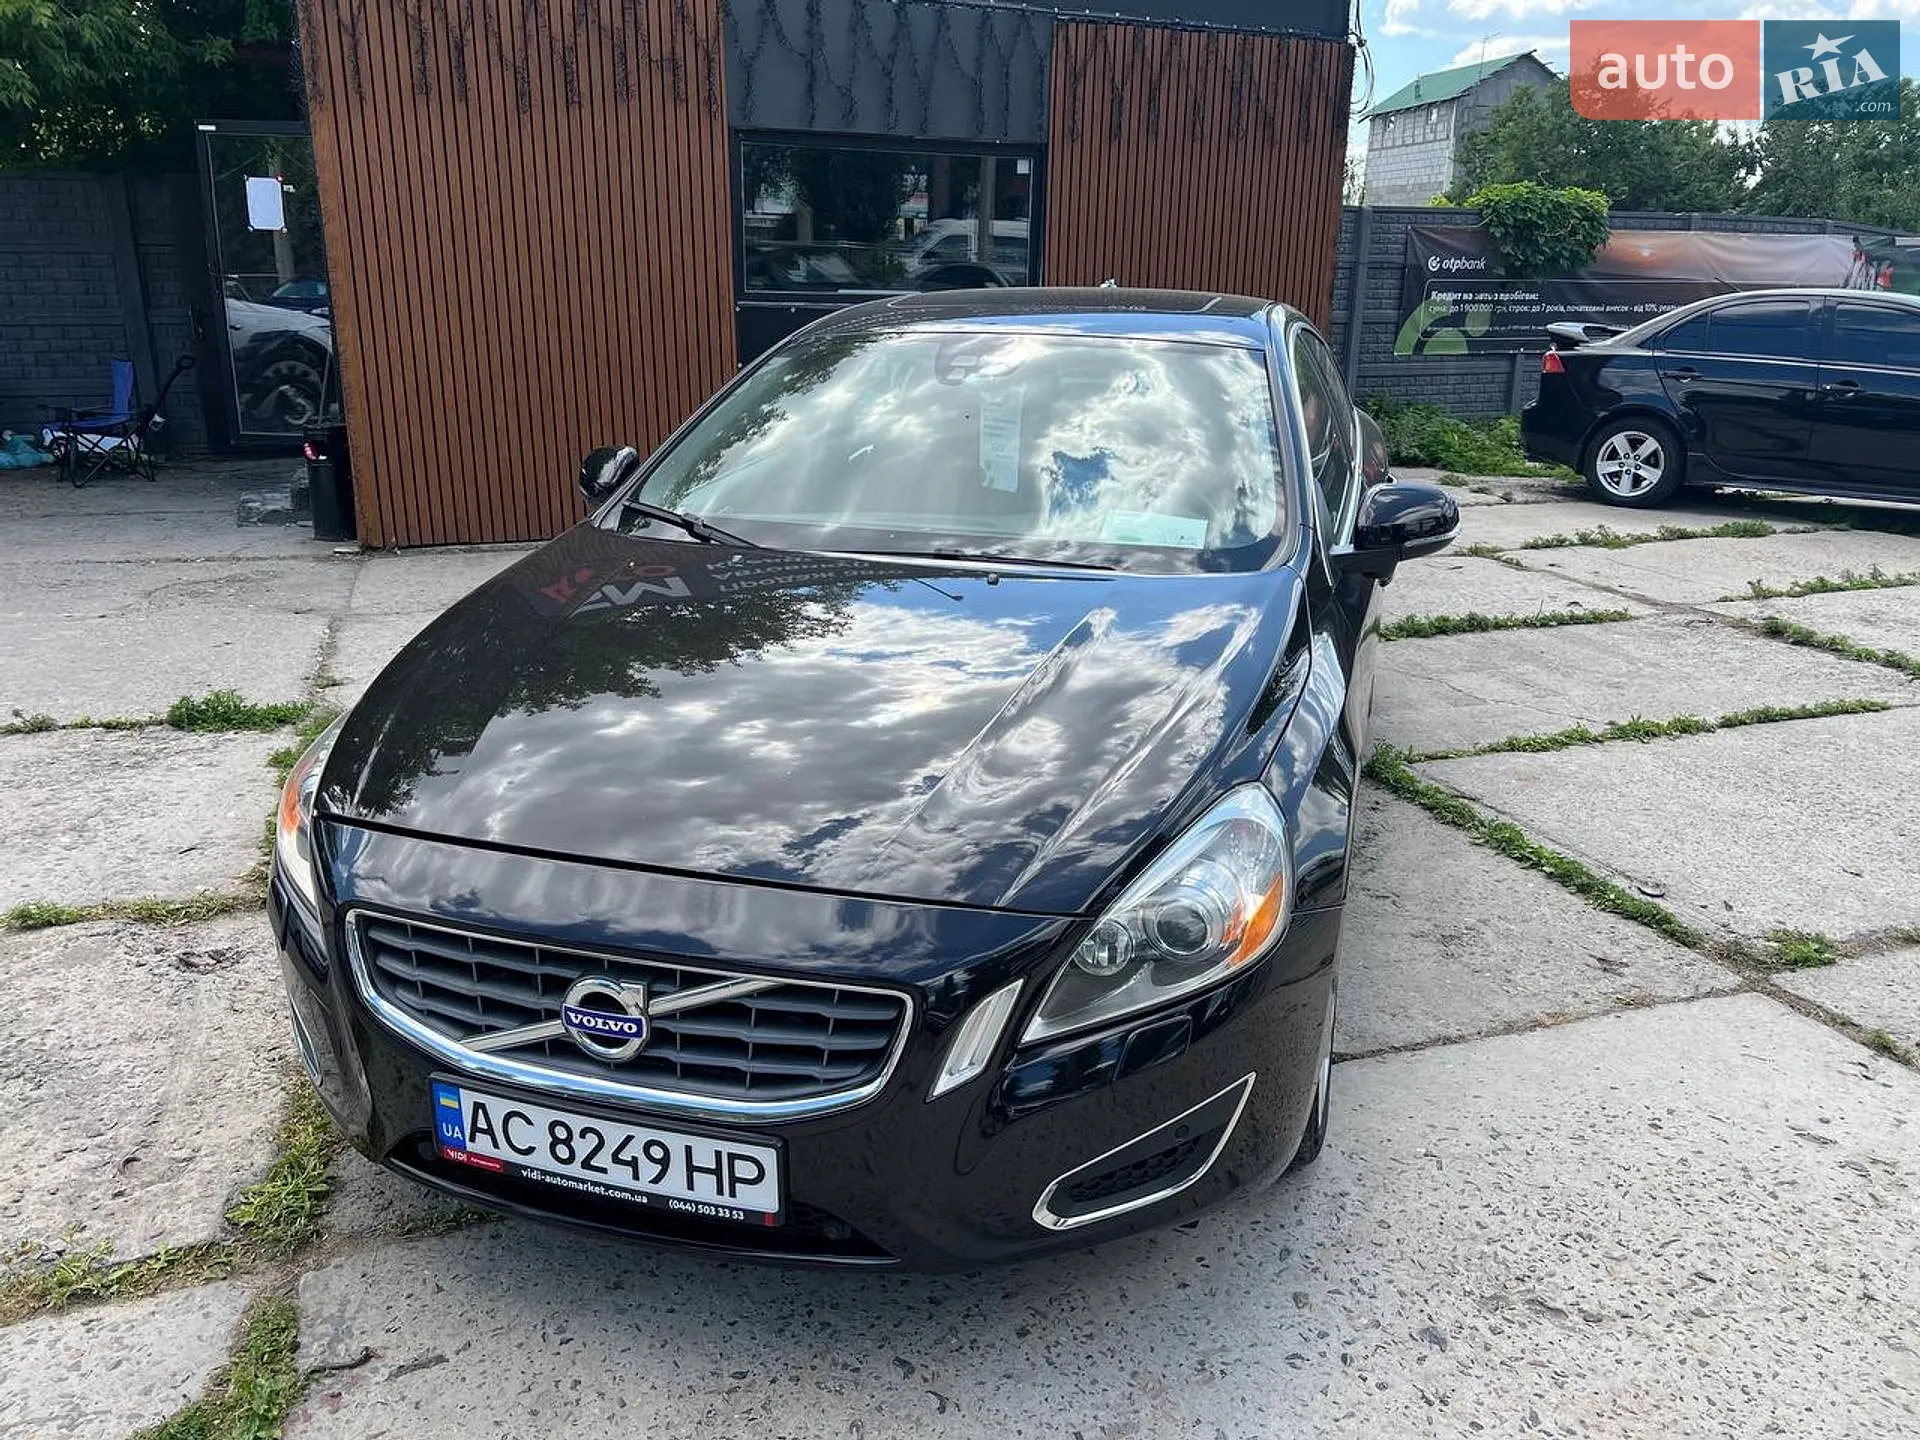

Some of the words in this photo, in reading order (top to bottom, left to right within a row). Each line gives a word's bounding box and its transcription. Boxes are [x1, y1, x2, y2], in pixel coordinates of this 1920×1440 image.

[1441, 256, 1487, 273] otpbank
[1431, 290, 1462, 302] Кредит
[1463, 292, 1473, 300] на
[1449, 304, 1459, 313] до
[566, 1010, 638, 1034] VOLVO
[443, 1121, 464, 1140] UA
[468, 1101, 536, 1156] AC
[547, 1119, 672, 1185] 8249
[684, 1144, 766, 1199] HP
[521, 1167, 649, 1204] vidi-automarket.com.ua
[668, 1199, 696, 1214] (044)
[697, 1204, 717, 1217] 503
[718, 1207, 731, 1219] 33
[732, 1209, 745, 1221] 53
